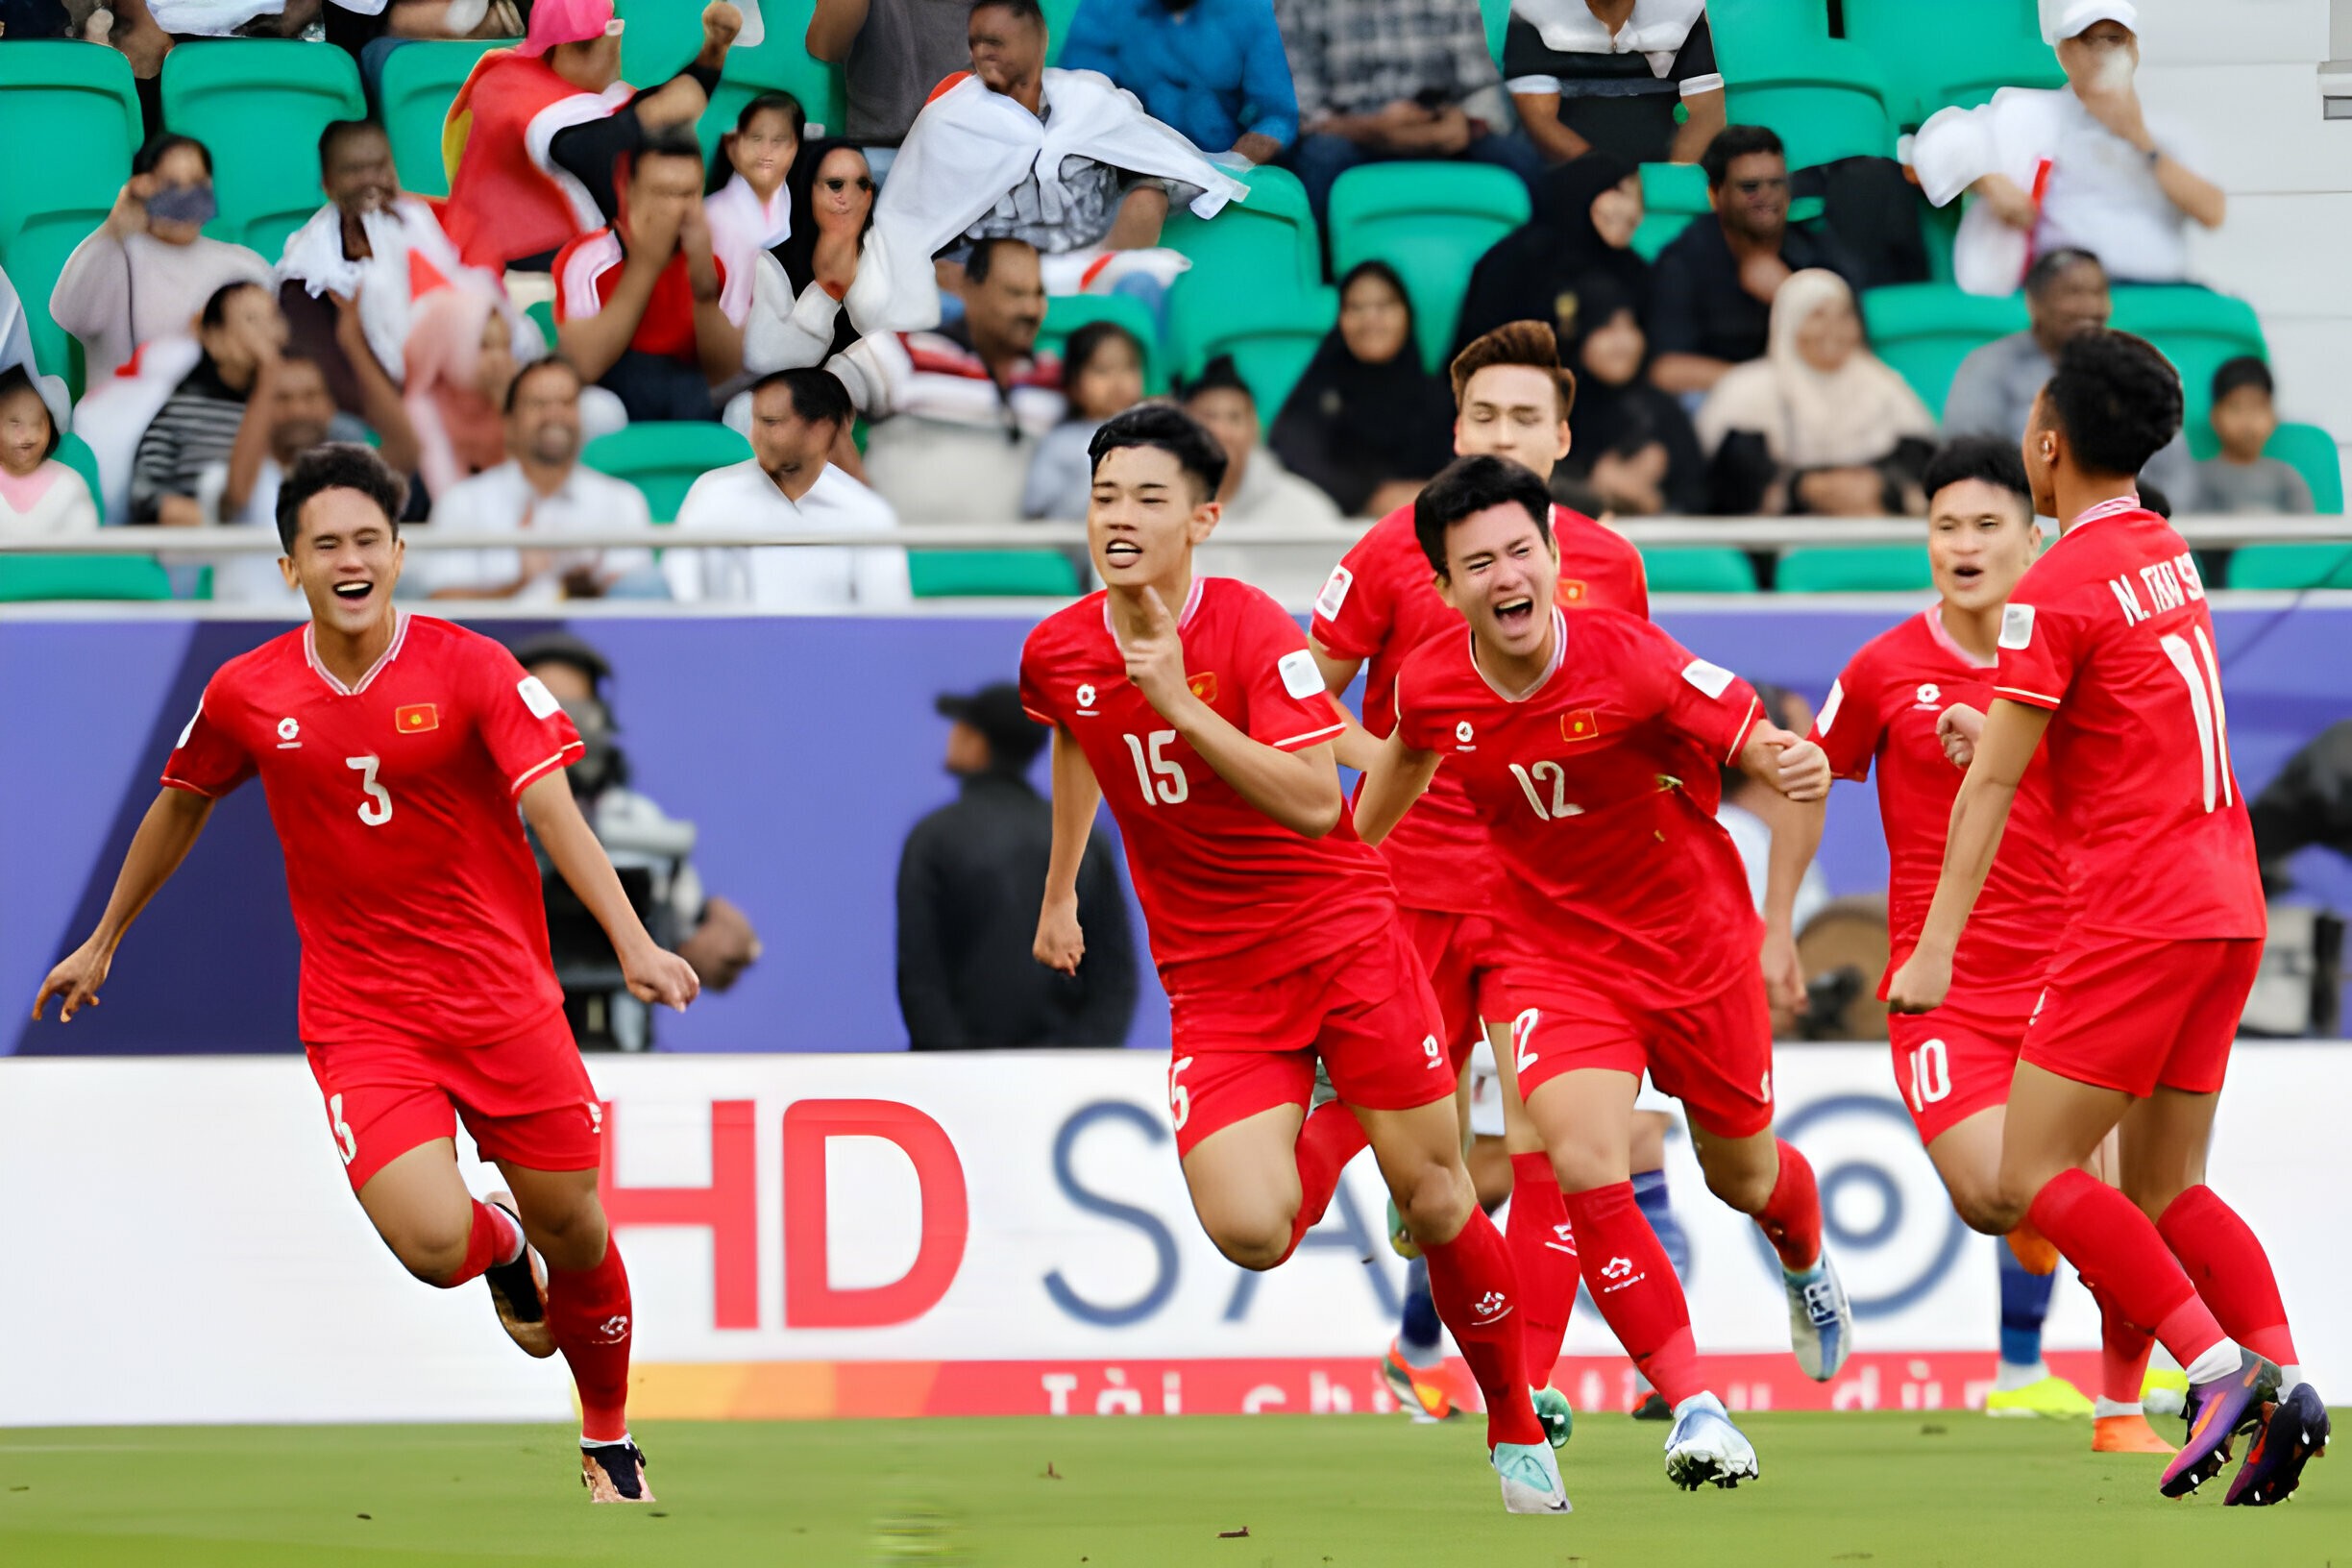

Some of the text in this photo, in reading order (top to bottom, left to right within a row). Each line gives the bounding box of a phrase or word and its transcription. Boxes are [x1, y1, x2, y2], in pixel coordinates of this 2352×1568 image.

[2159, 625, 2233, 814] 11
[346, 755, 393, 826] 3
[1122, 729, 1188, 805] 15
[1508, 761, 1583, 821] 12
[1909, 1038, 1952, 1113] 10
[601, 1097, 970, 1331] HD
